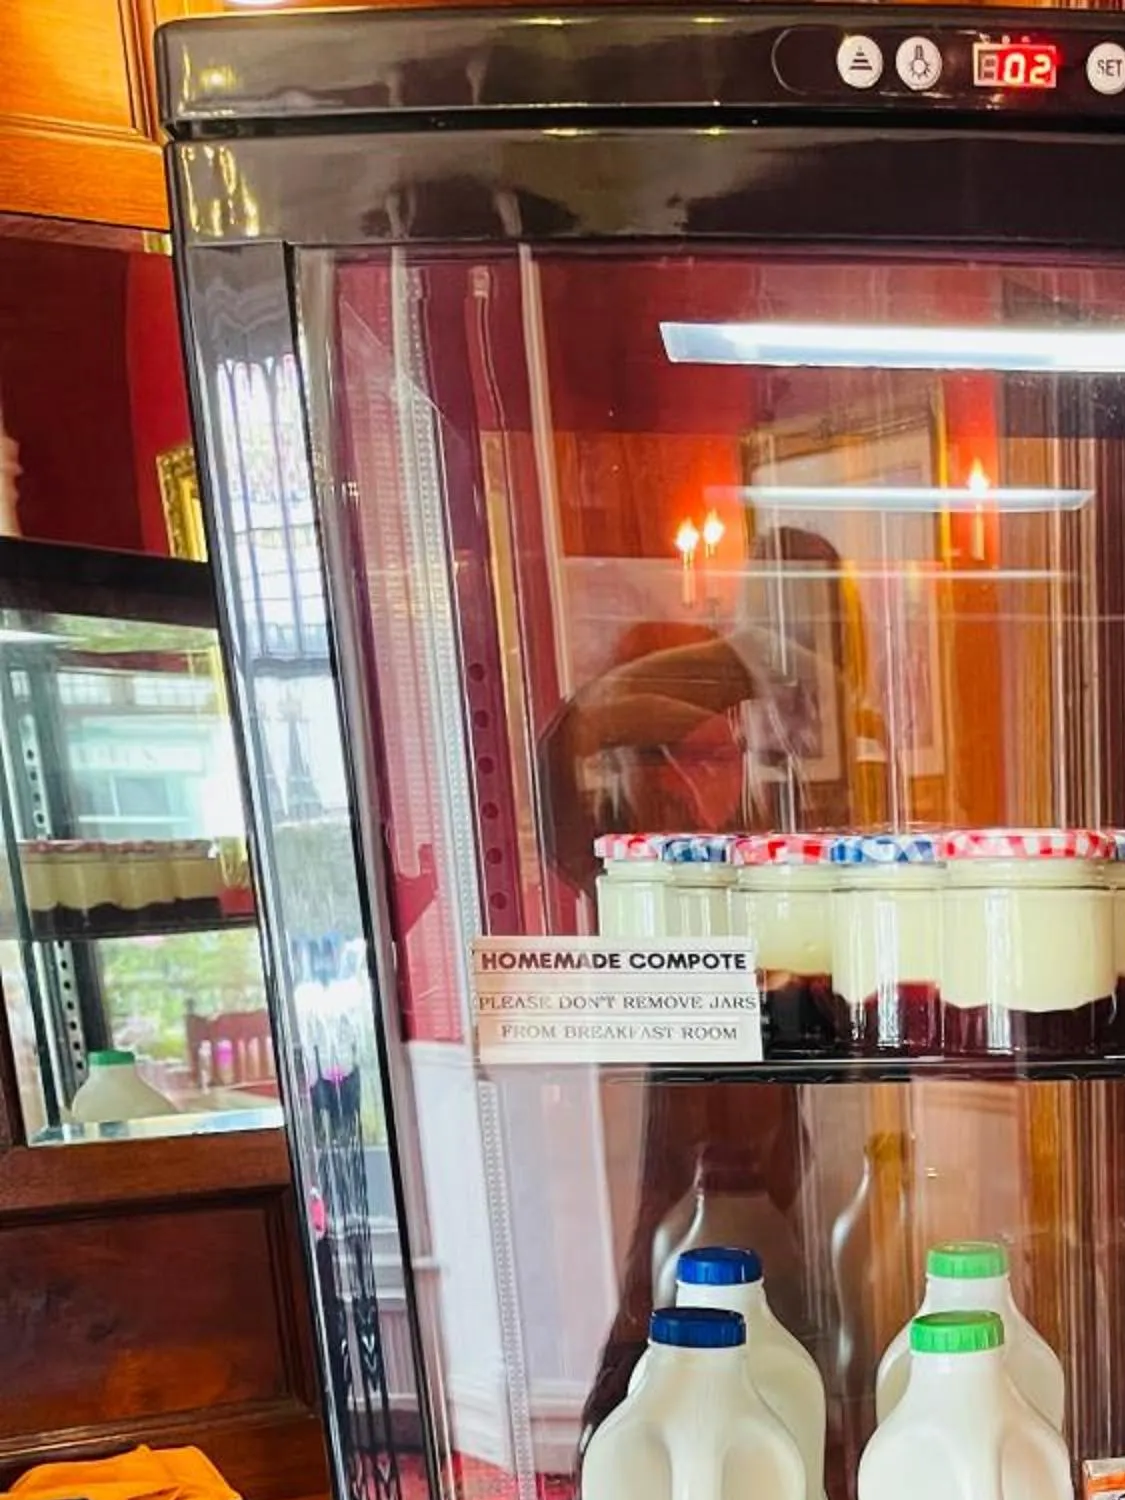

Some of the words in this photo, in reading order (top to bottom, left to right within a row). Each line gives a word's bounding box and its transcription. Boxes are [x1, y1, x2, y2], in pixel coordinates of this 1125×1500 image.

[1096, 58, 1123, 78] SET
[482, 952, 621, 970] HOMEMADE
[629, 952, 747, 970] COMPOTE
[479, 997, 555, 1011] PLEASE
[559, 995, 615, 1010] DON'T
[623, 995, 702, 1010] REMOVE
[709, 996, 757, 1011] JARS
[501, 1025, 557, 1039] FROM
[564, 1025, 674, 1040] BREAKFAST
[681, 1026, 738, 1040] ROOM
